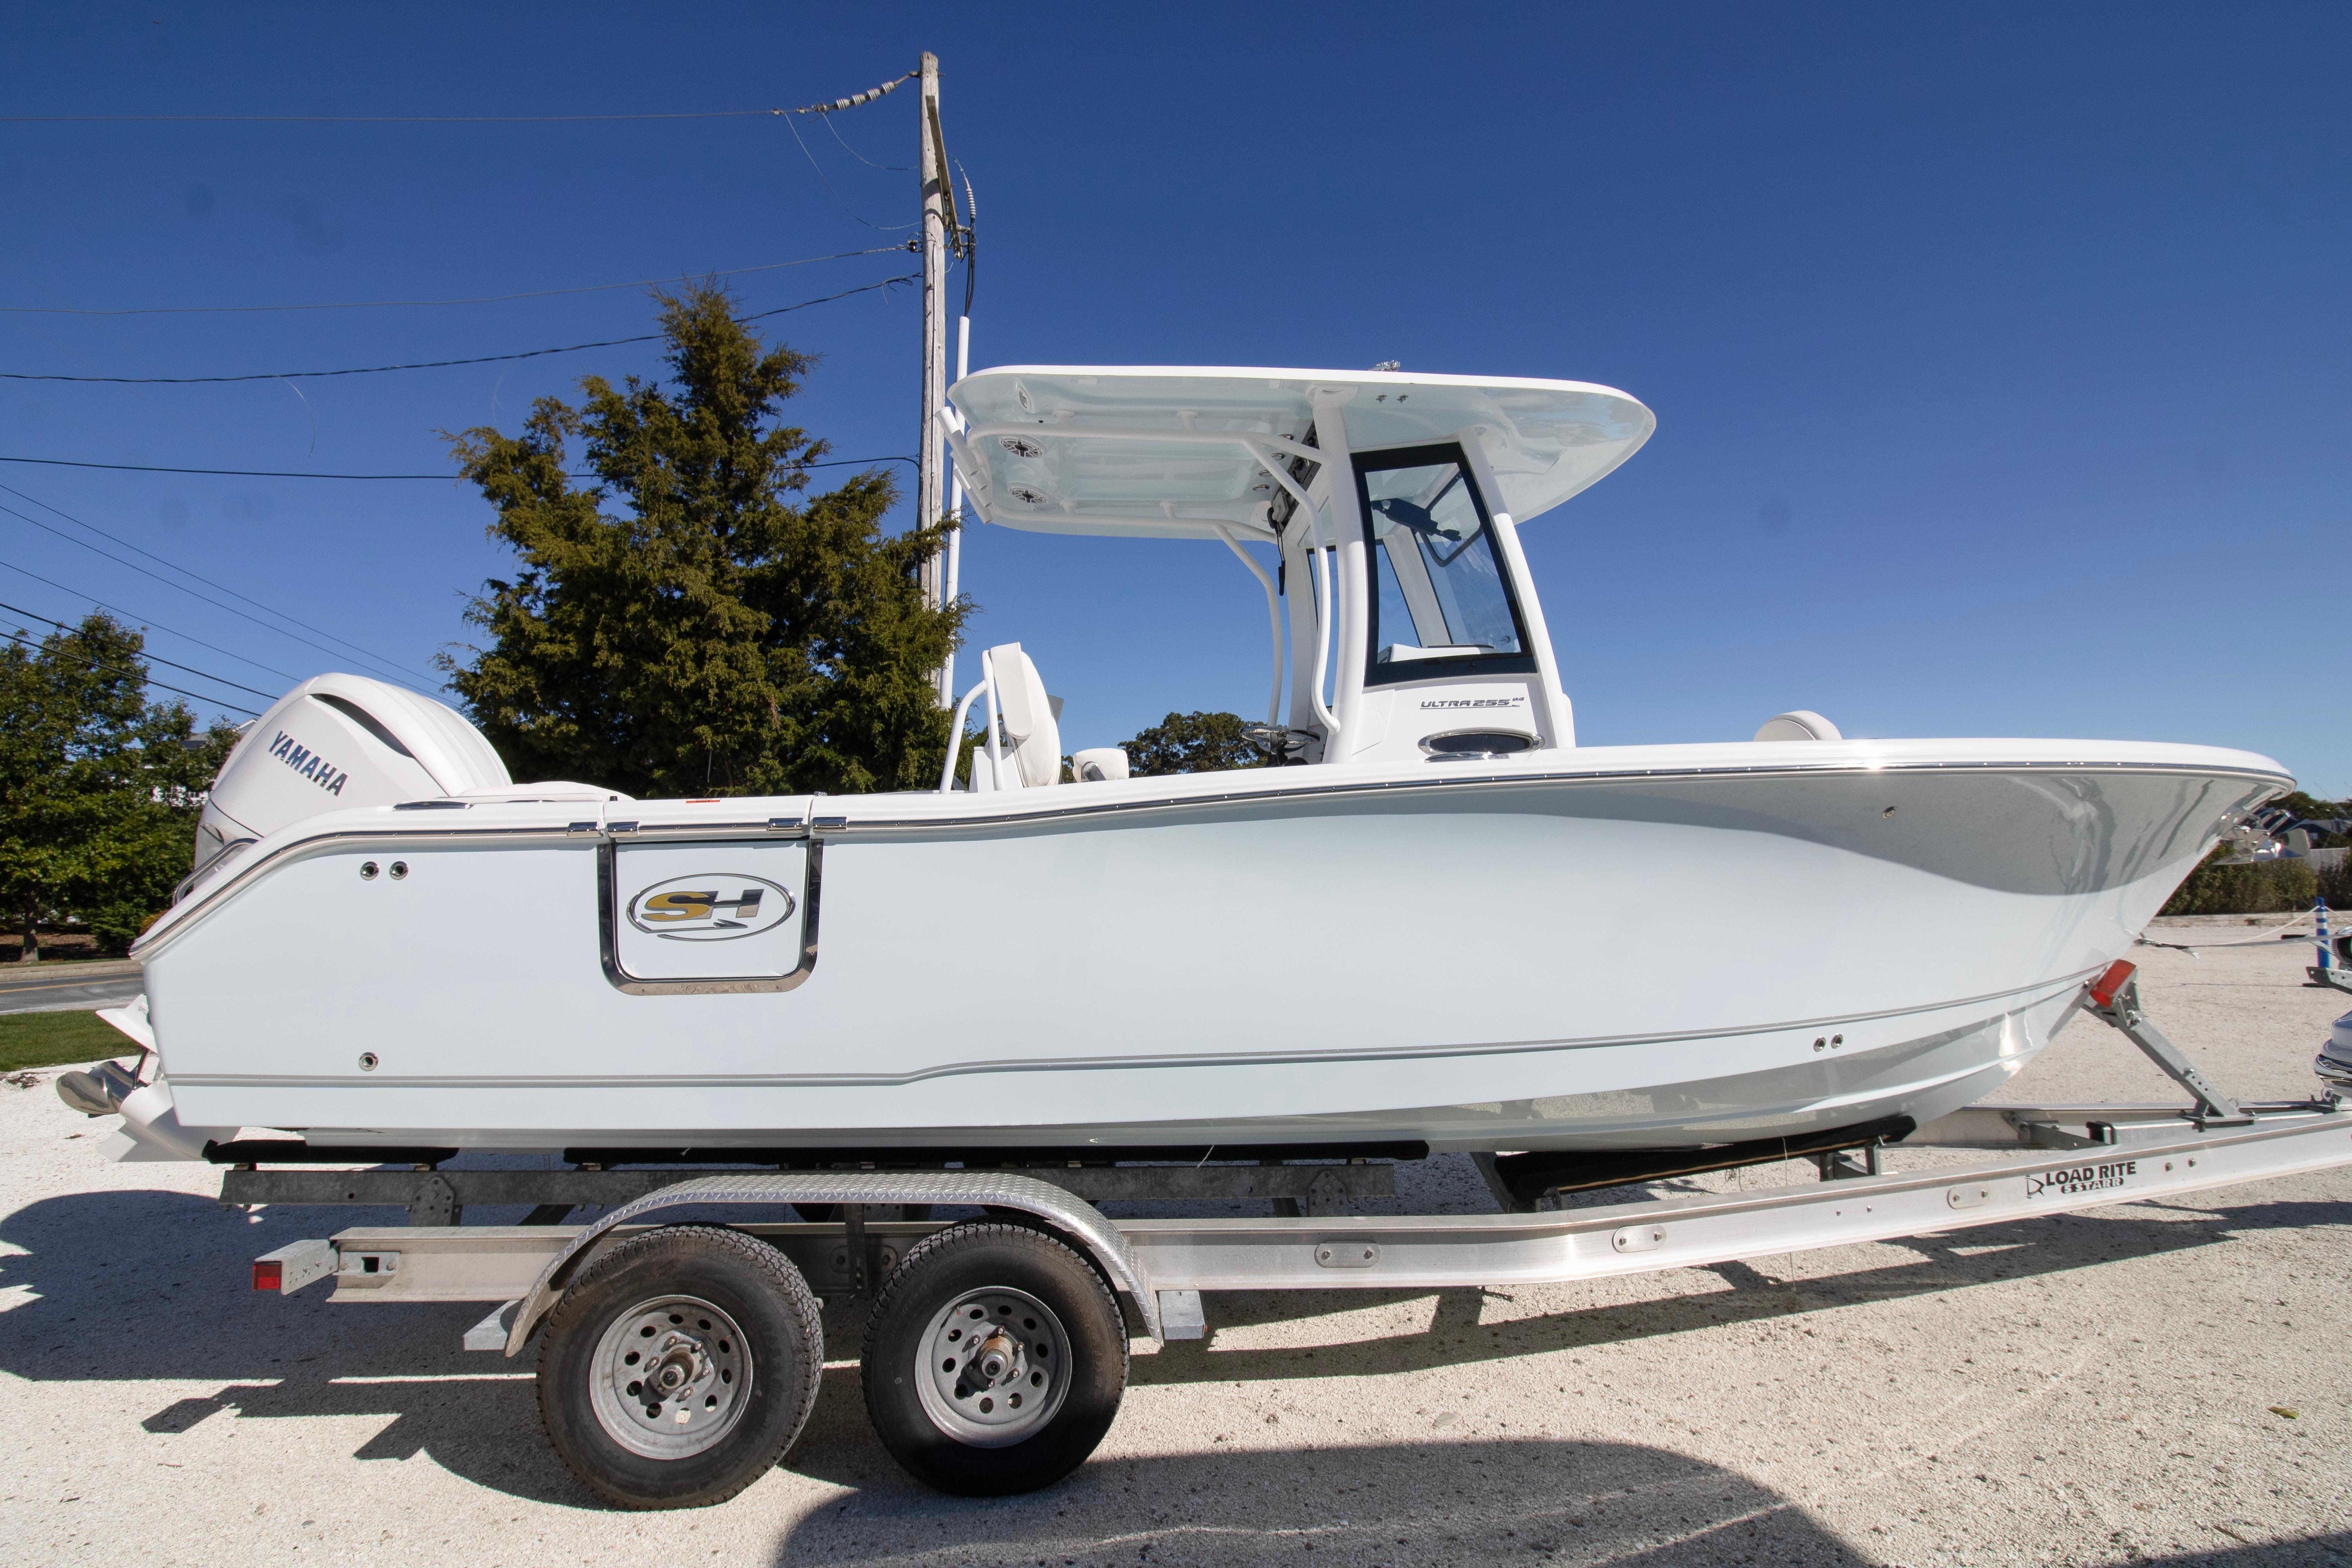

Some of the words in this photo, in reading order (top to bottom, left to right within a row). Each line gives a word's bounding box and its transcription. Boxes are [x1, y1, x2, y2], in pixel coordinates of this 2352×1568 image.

[268, 730, 348, 797] YAMAHA
[641, 888, 764, 922] SH
[2045, 1167, 2094, 1186] LOAD
[2099, 1161, 2136, 1179] RITE
[2064, 1185, 2073, 1193] 5
[2075, 1178, 2121, 1192] STARR
